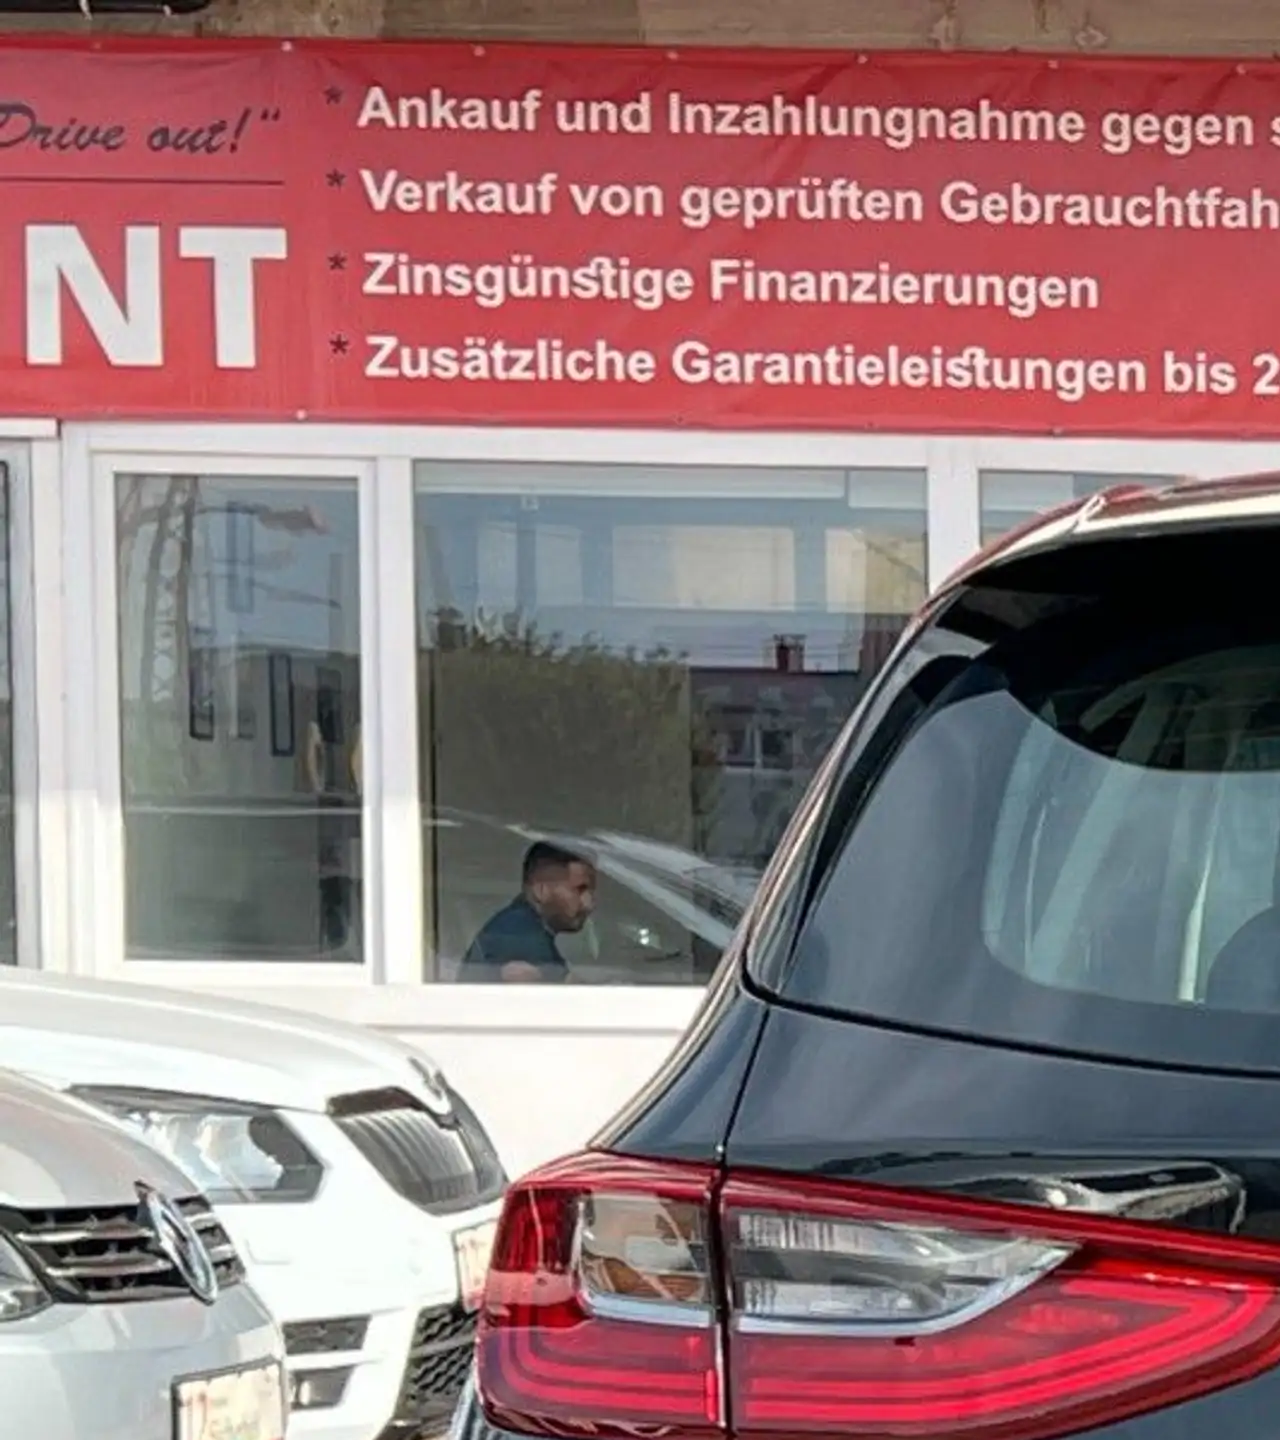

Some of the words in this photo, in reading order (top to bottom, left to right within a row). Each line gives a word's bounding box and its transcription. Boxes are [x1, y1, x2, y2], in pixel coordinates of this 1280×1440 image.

[358, 86, 541, 131] Ankauf
[557, 92, 651, 134] und
[669, 92, 1086, 149] Inzahlungnahme
[1101, 112, 1254, 156] gegen
[359, 168, 558, 215] Verkauf
[568, 183, 664, 217] von
[680, 177, 924, 229] geprüften
[361, 251, 695, 311] Zinsgünstige
[710, 258, 1099, 319] Finanzierungen
[364, 334, 657, 384] Zusätzliche
[671, 339, 1147, 403] Garantieleistungen
[1163, 349, 1237, 395] bis
